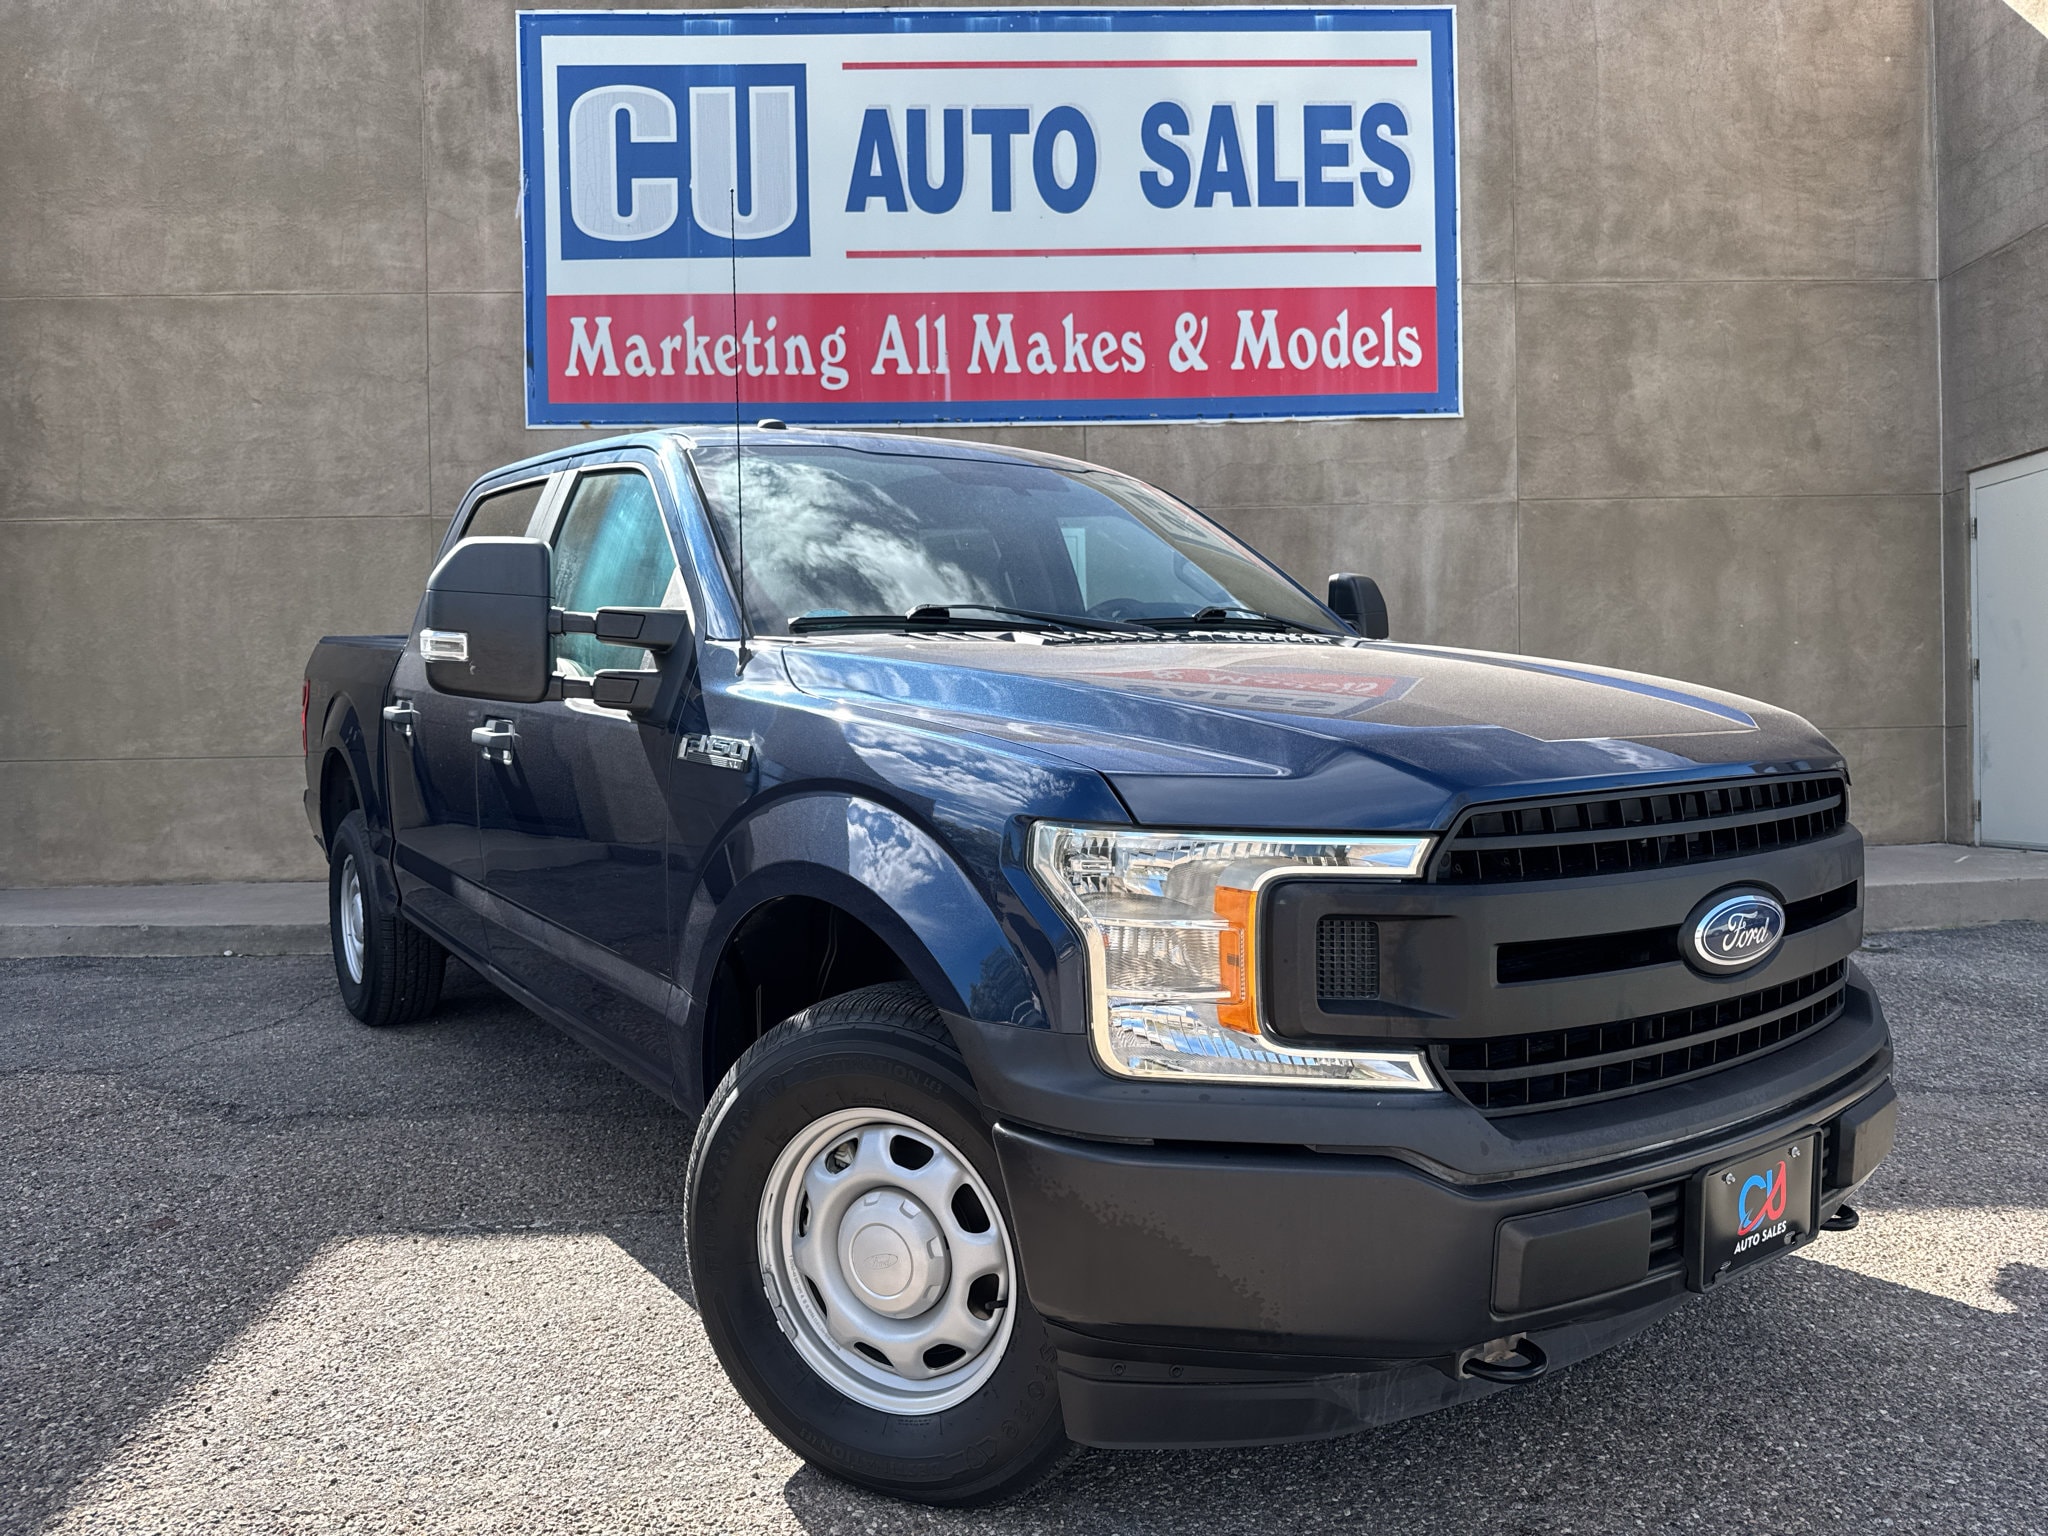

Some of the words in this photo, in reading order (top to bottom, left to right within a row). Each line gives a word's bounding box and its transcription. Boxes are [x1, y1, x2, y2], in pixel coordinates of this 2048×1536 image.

[569, 84, 798, 242] CU
[845, 104, 1100, 215] AUTO
[1139, 100, 1412, 209] SALES
[564, 315, 849, 390] Marketing
[871, 313, 951, 376] All
[967, 312, 1146, 375] Makes
[1168, 311, 1208, 372] &
[1230, 307, 1423, 370] Models
[1722, 911, 1770, 952] Ford
[1733, 1232, 1760, 1255] AUTO
[1761, 1220, 1788, 1243] SALES
